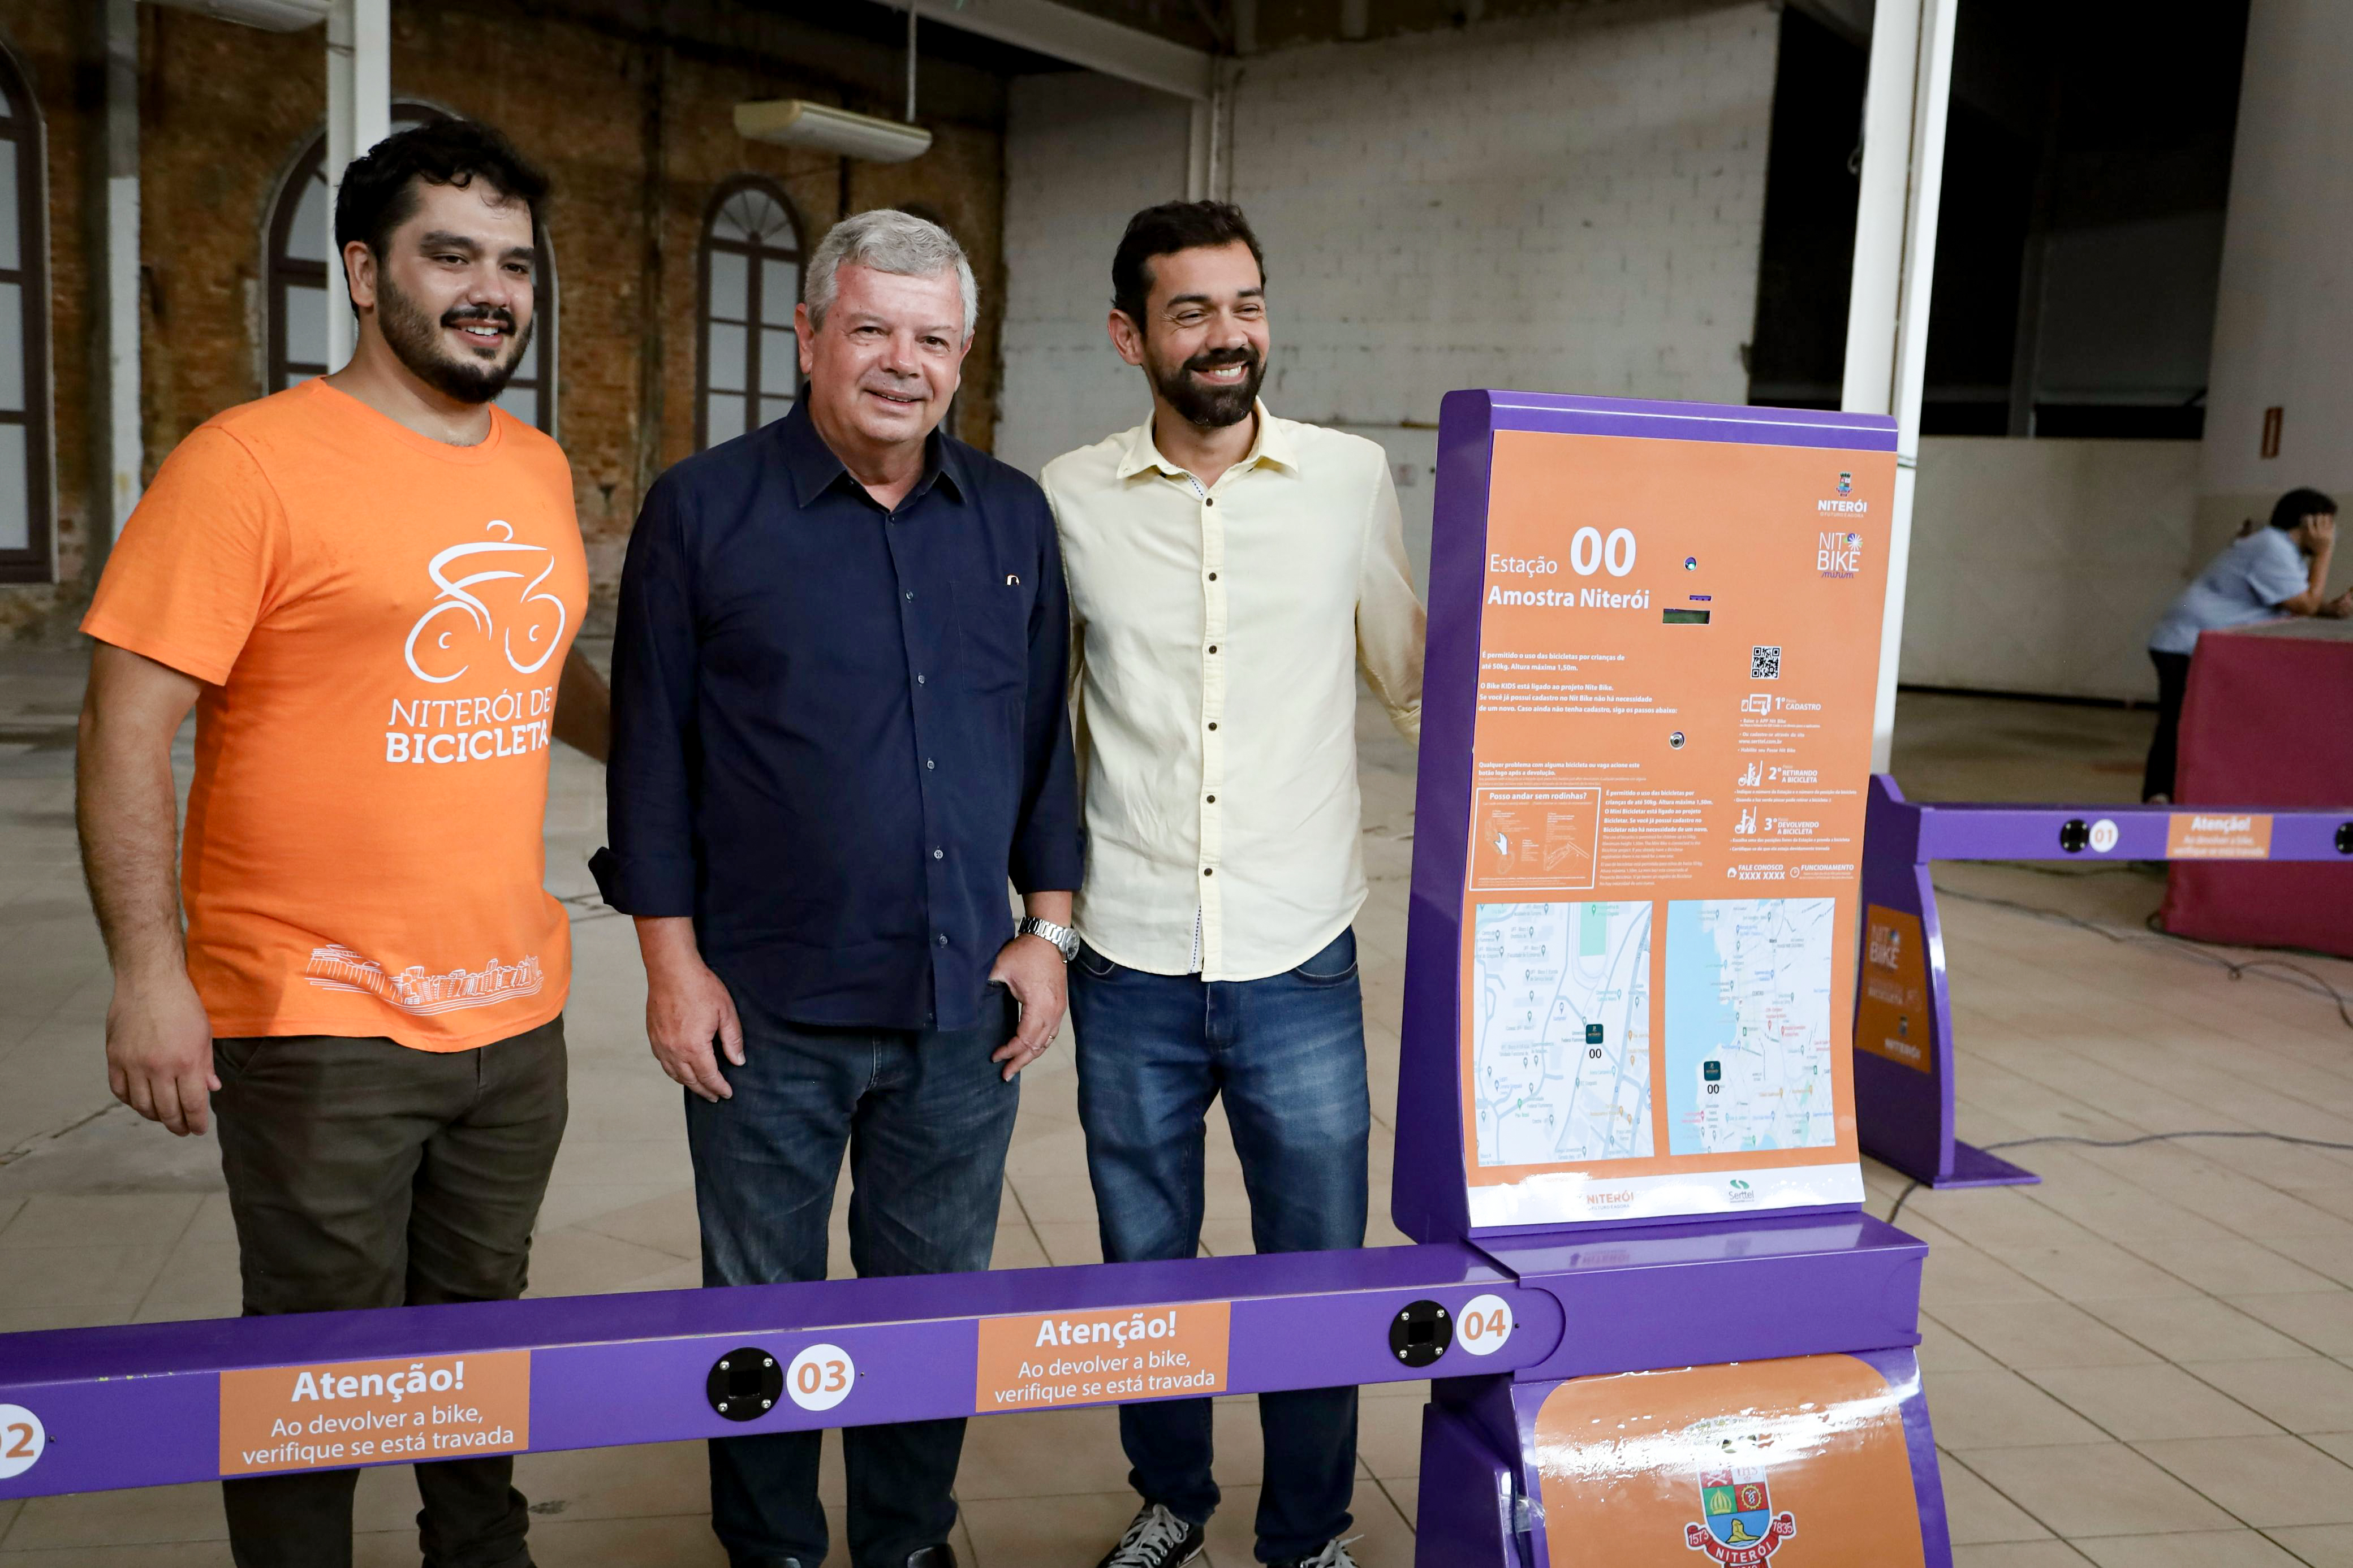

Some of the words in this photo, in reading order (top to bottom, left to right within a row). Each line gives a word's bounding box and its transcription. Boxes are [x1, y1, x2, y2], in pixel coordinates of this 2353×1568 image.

[1817, 499, 1867, 513] NITERÓI
[1489, 554, 1558, 578] Estação
[1570, 526, 1636, 577] 00
[1819, 532, 1846, 550] NIT
[1817, 550, 1861, 572] BIKE
[1487, 585, 1575, 607] Amostra
[1580, 588, 1649, 610] Niterói
[388, 689, 523, 728] NITERÓI
[530, 686, 553, 714] DE
[1775, 697, 1785, 710] 1º
[385, 719, 549, 764] BICICLETA
[1768, 766, 1781, 780] 2º
[1764, 818, 1777, 831] 3º
[2095, 828, 2113, 843] 01
[1739, 871, 1761, 880] XXXX
[1589, 1049, 1602, 1059] 00
[1707, 1084, 1720, 1095] 00
[1587, 1189, 1634, 1204] NITERÓI
[1729, 1190, 1755, 1201] Serttel
[1035, 1311, 1177, 1349] Atenção!
[1464, 1308, 1506, 1341] 04
[1018, 1362, 1044, 1379] Ao
[1049, 1355, 1129, 1376] devolver
[1133, 1357, 1143, 1370] a
[1149, 1350, 1191, 1368] bike,
[291, 1360, 464, 1403] Atenção!
[797, 1360, 846, 1394] 03
[994, 1383, 1077, 1403] verifique
[1082, 1382, 1102, 1396] se
[1106, 1375, 1143, 1394] está
[1148, 1370, 1216, 1389] travada
[271, 1418, 302, 1437] Ao
[309, 1411, 407, 1435] devolver
[413, 1412, 425, 1426] a
[432, 1404, 484, 1424] bike,
[0, 1422, 35, 1458] 2
[242, 1442, 344, 1464] verifique
[351, 1441, 375, 1456] se
[381, 1432, 425, 1454] está
[432, 1426, 514, 1449] travada
[1688, 1528, 1709, 1545] 1573
[1773, 1521, 1794, 1534] 1835
[1716, 1541, 1772, 1563] NITERÓI
